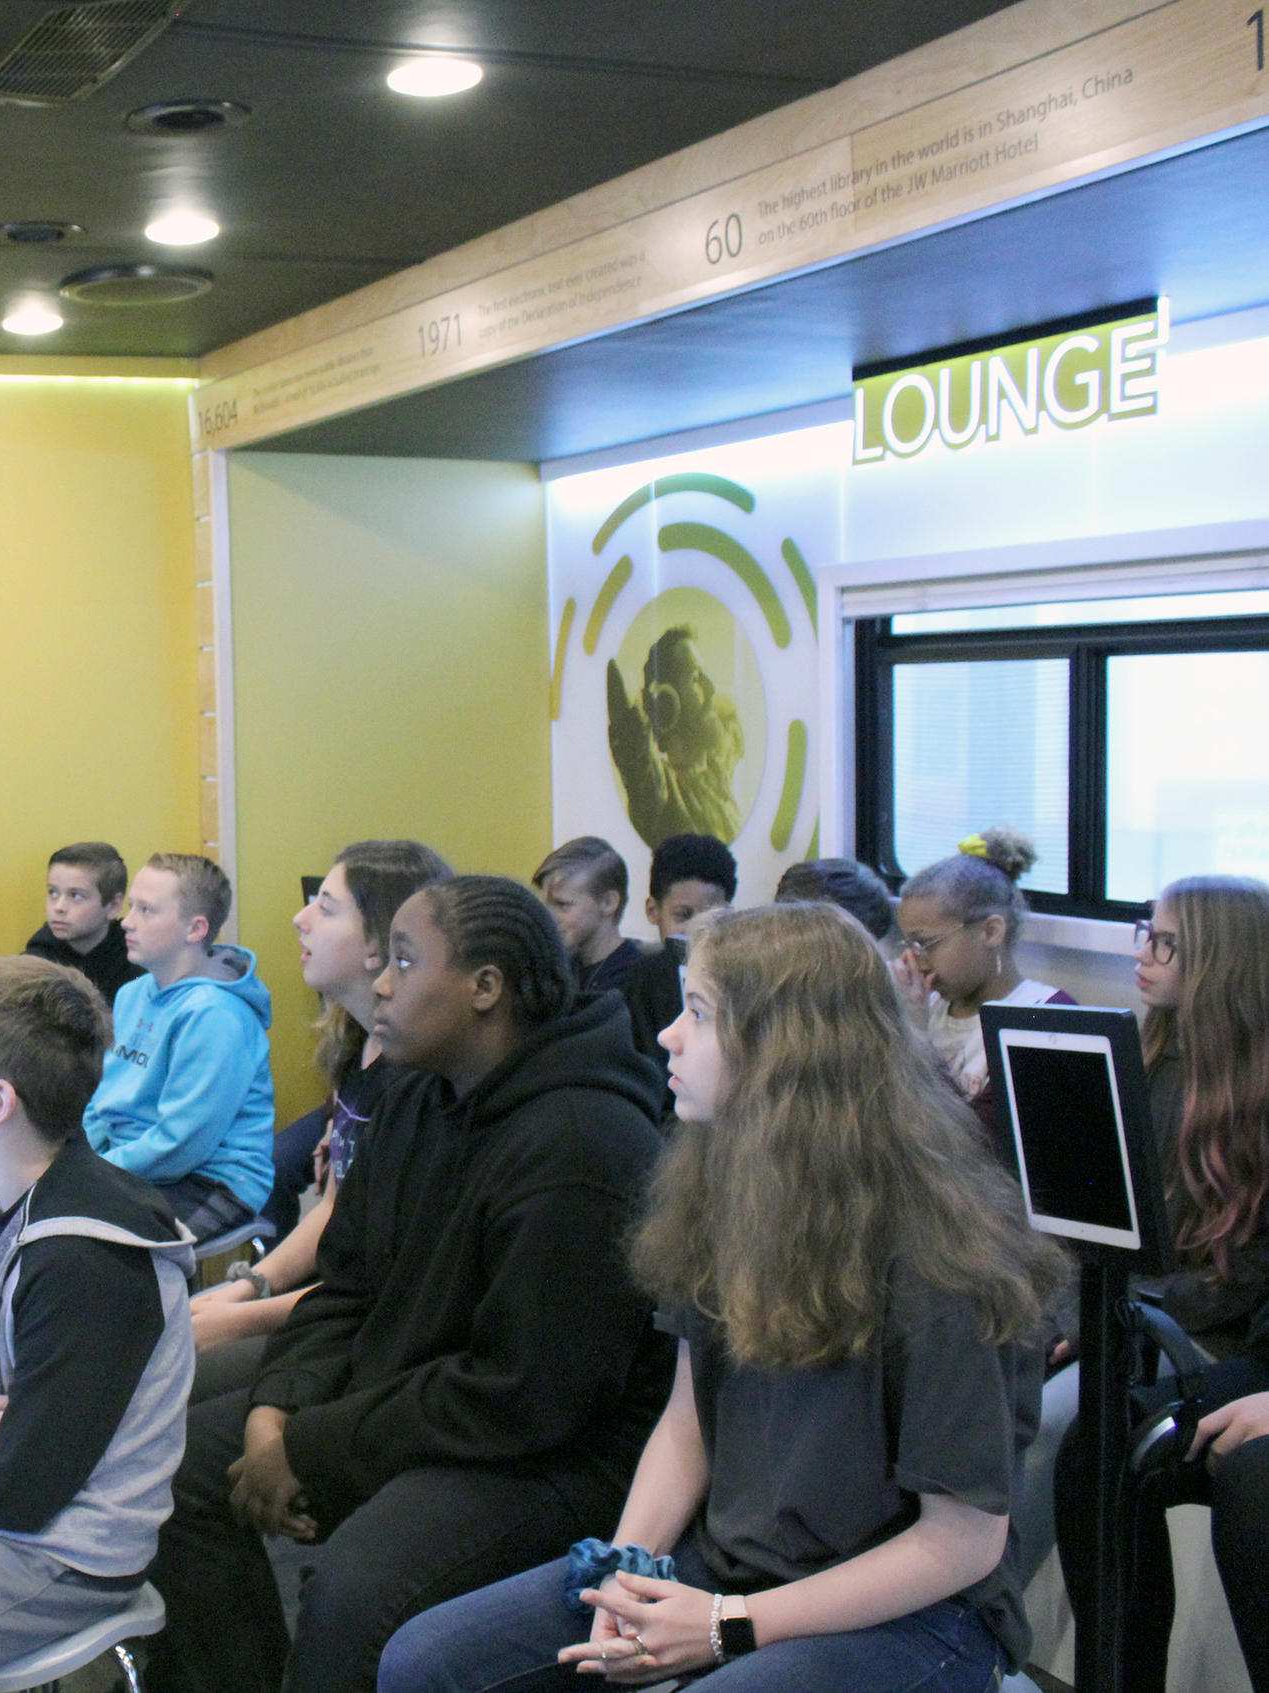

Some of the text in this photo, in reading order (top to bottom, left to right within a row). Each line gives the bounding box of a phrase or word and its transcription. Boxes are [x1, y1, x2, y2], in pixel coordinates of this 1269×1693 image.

[758, 67, 1134, 218] The highest library in the world is in Shanghai, China
[759, 132, 1040, 245] on the 60th floor of the JW Marriott Hotel
[705, 212, 744, 265] 60
[418, 312, 462, 359] 1971
[198, 399, 239, 437] 16,604
[854, 319, 1158, 463] LOUNGE
